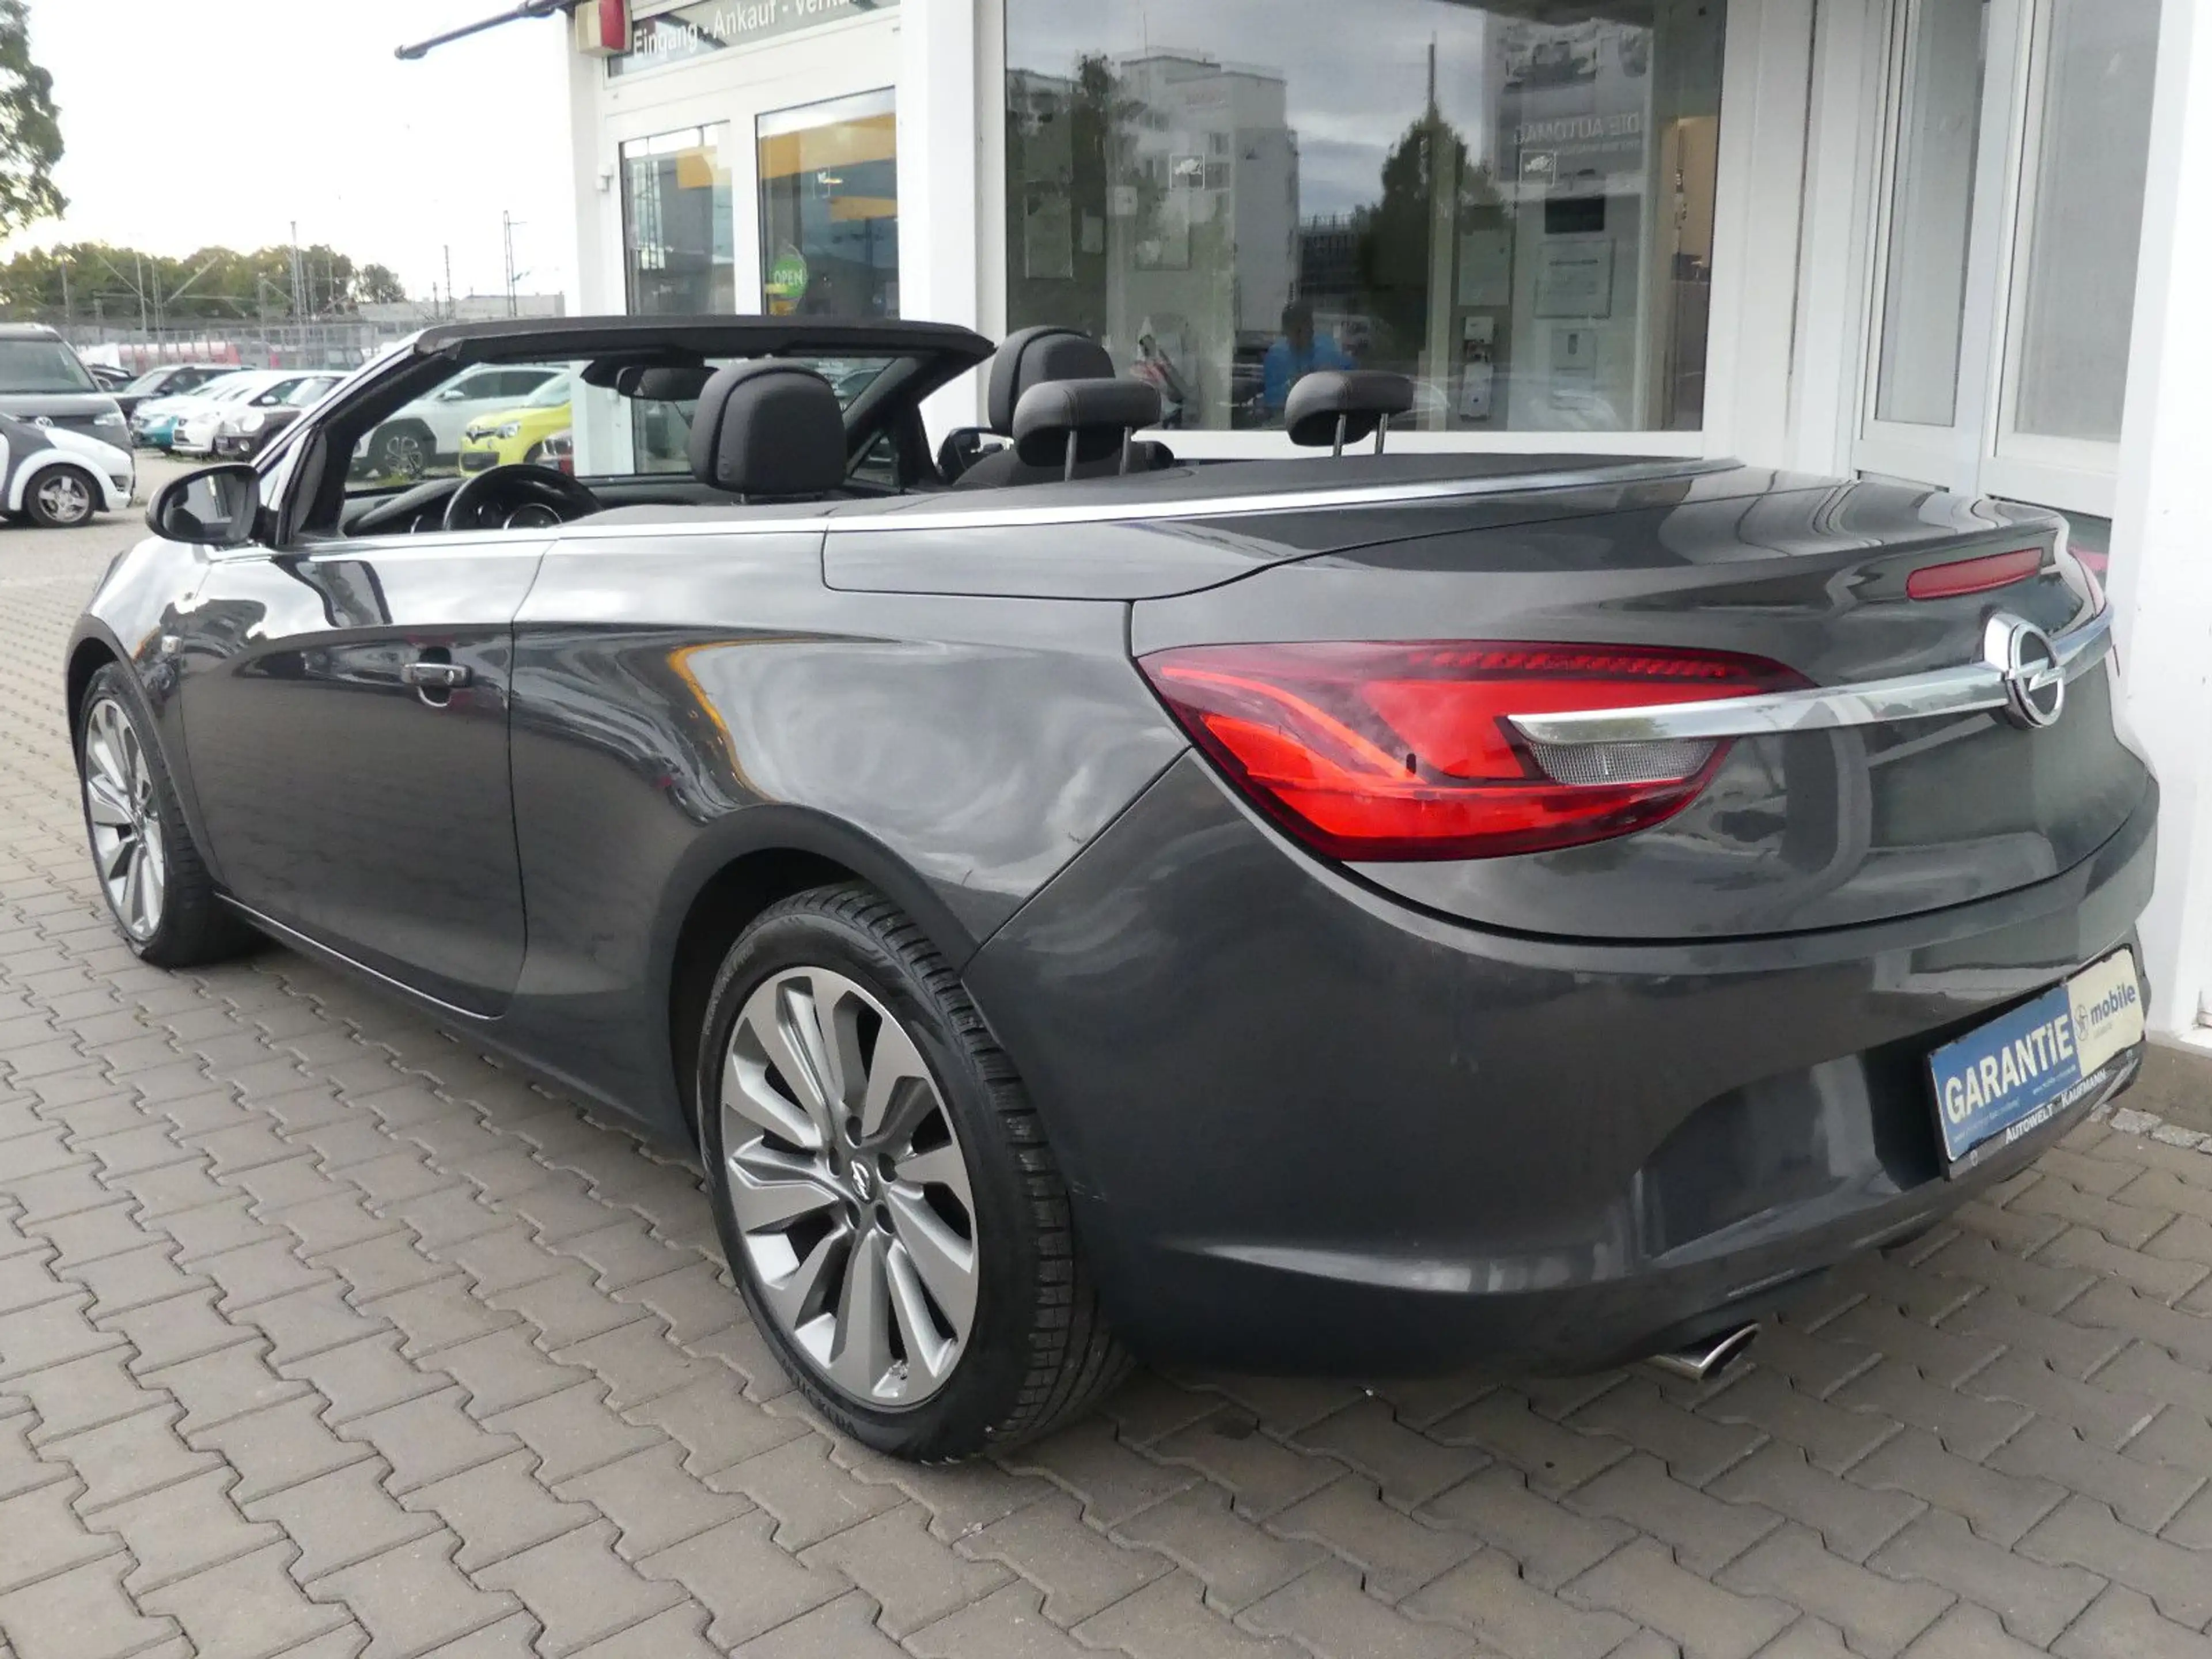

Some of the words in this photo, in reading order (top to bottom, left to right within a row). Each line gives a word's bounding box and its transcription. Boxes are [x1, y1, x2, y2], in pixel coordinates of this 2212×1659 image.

[633, 22, 698, 58] Eingang
[713, 0, 778, 39] Ankauf
[2090, 982, 2136, 1025] mobile
[1945, 1012, 2073, 1124] GARANTIE
